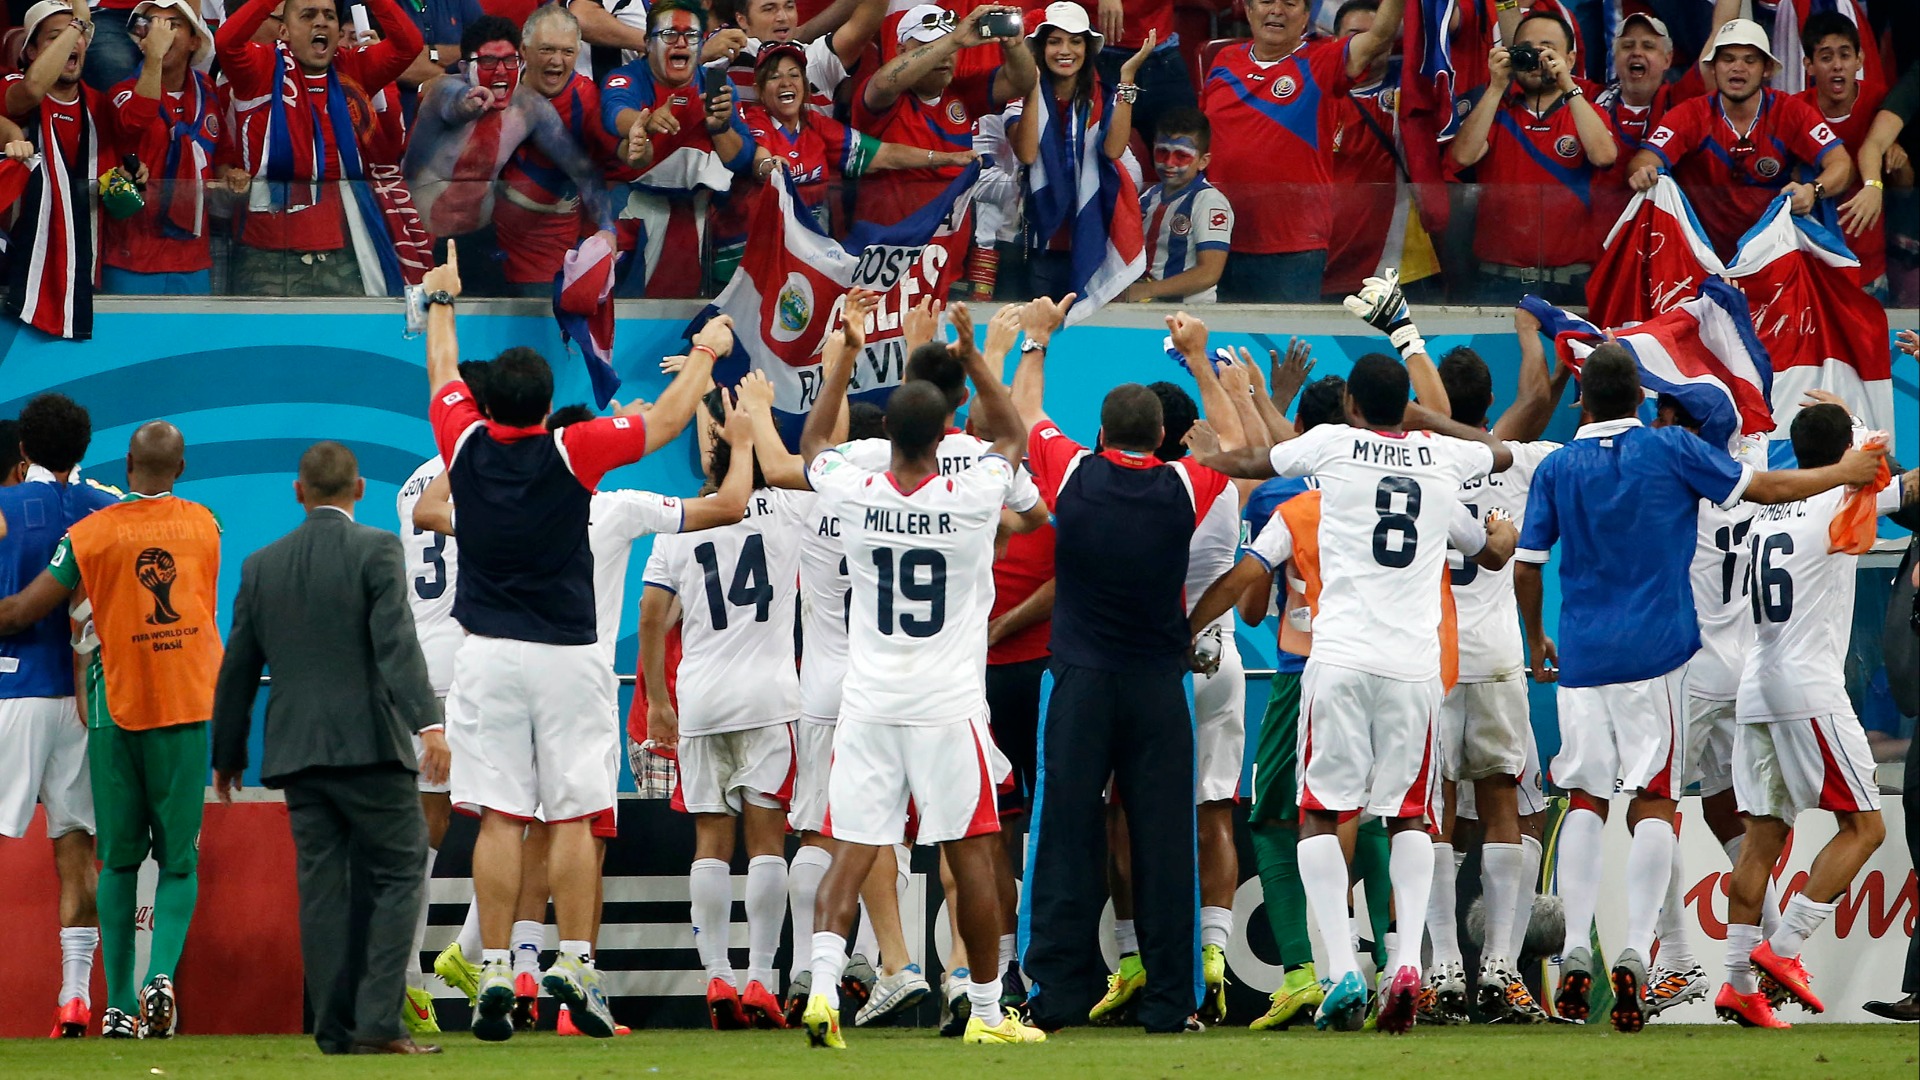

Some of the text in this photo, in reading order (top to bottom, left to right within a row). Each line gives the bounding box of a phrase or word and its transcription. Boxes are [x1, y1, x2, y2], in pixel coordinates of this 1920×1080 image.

[1352, 439, 1437, 468] MYRIE D.
[756, 497, 774, 516] R.
[864, 507, 958, 535] MILLER R.
[1372, 475, 1422, 569] 8
[694, 533, 774, 631] 14
[872, 547, 947, 638] 19
[1751, 532, 1794, 624] 16
[131, 626, 199, 643] FIFA WORLD CUP
[152, 639, 183, 653] Brasil
